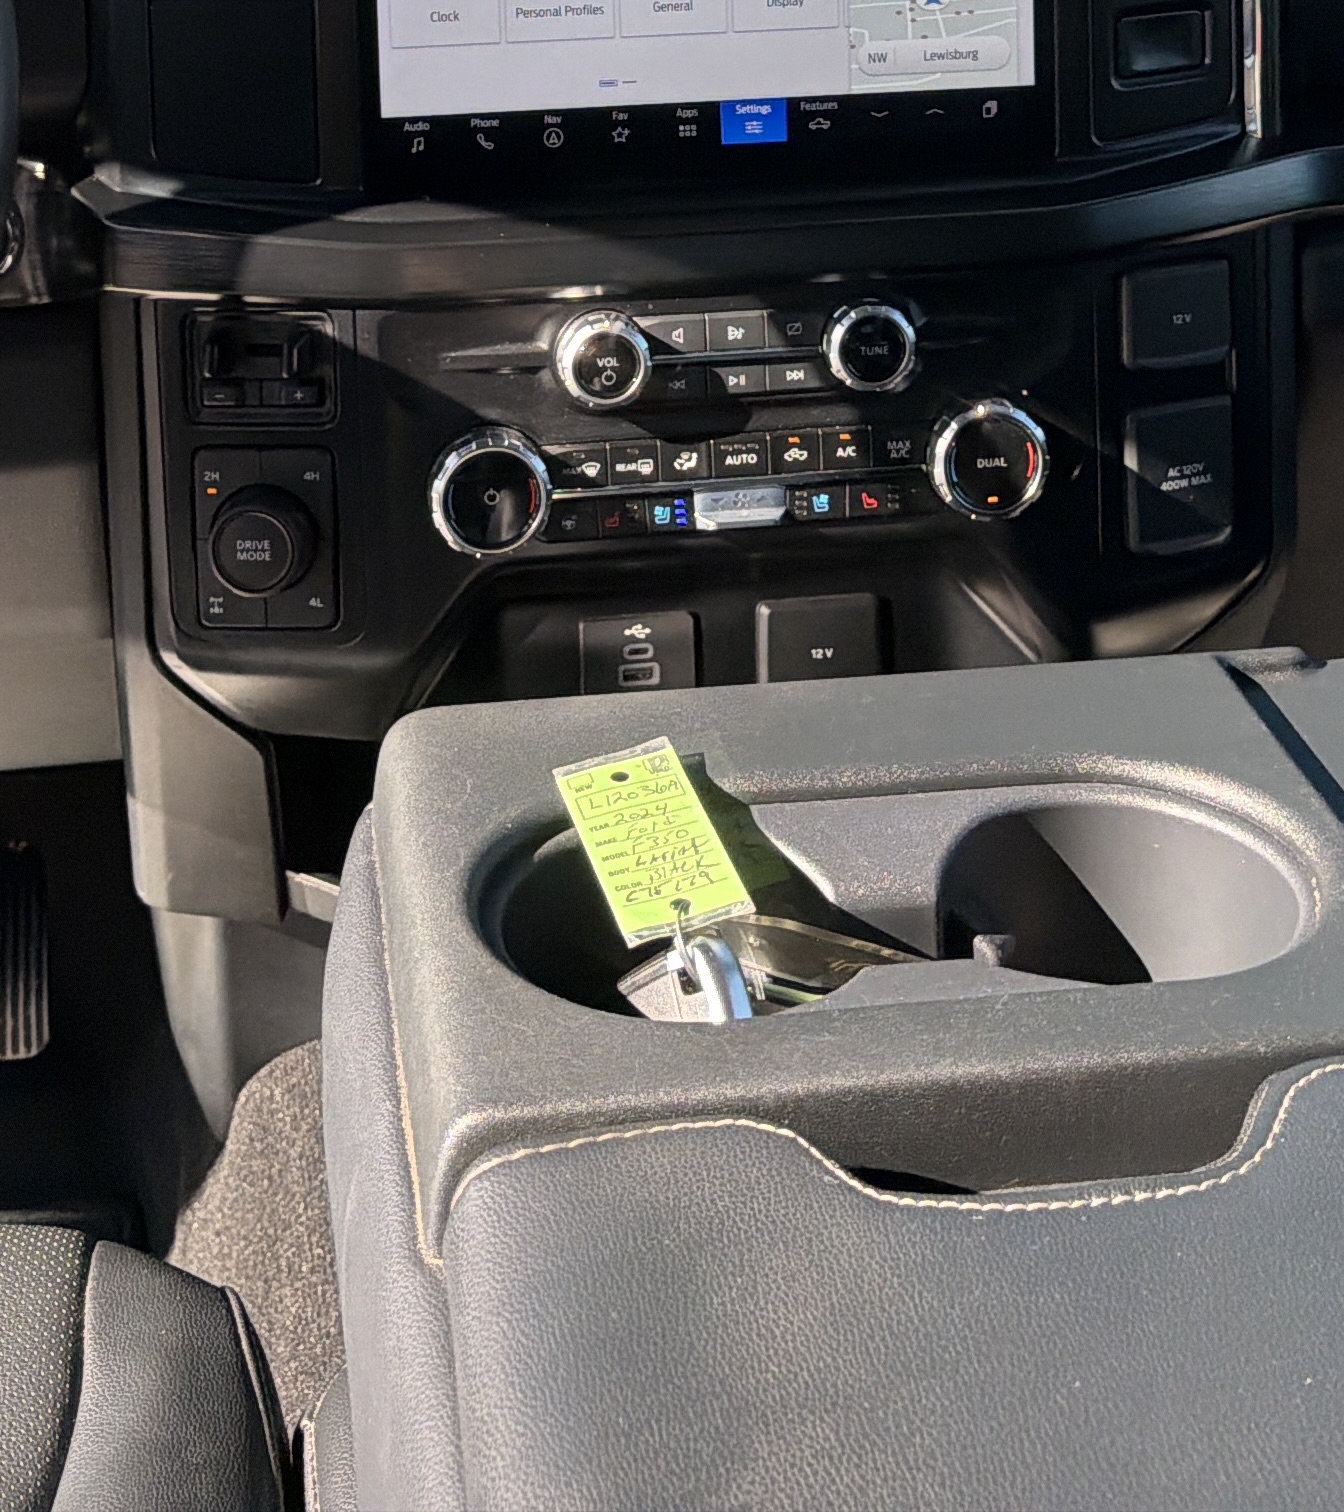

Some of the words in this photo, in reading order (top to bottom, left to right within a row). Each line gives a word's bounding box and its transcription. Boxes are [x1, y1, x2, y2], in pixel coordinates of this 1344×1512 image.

[429, 8, 461, 24] Clock
[515, 4, 563, 20] Personal
[565, 2, 605, 18] Profiles
[867, 52, 888, 64] NW
[923, 48, 979, 62] Lewisburg
[676, 105, 699, 119] Apps
[735, 102, 772, 117] Settings
[800, 99, 839, 112] Features
[544, 113, 562, 125] Nav
[611, 109, 629, 122] Fav
[403, 119, 430, 133] Audio
[470, 115, 500, 130] Phone
[860, 344, 889, 357] TUNE
[596, 356, 620, 368] VOL
[835, 445, 858, 458] A/C
[887, 439, 911, 451] MAX
[724, 453, 758, 467] AUTO
[889, 448, 911, 459] A/C
[615, 462, 638, 472] REAR
[976, 456, 1007, 469] DUAL
[203, 471, 220, 482] 2H
[303, 471, 320, 481] 4H
[1167, 466, 1182, 478] AC
[1190, 474, 1213, 487] MAX
[236, 539, 271, 550] DRIVE
[236, 550, 272, 561] MODE
[309, 597, 324, 608] 4L
[613, 802, 668, 826] 2024
[589, 822, 611, 833] YEAR
[615, 881, 643, 892] COLOR
